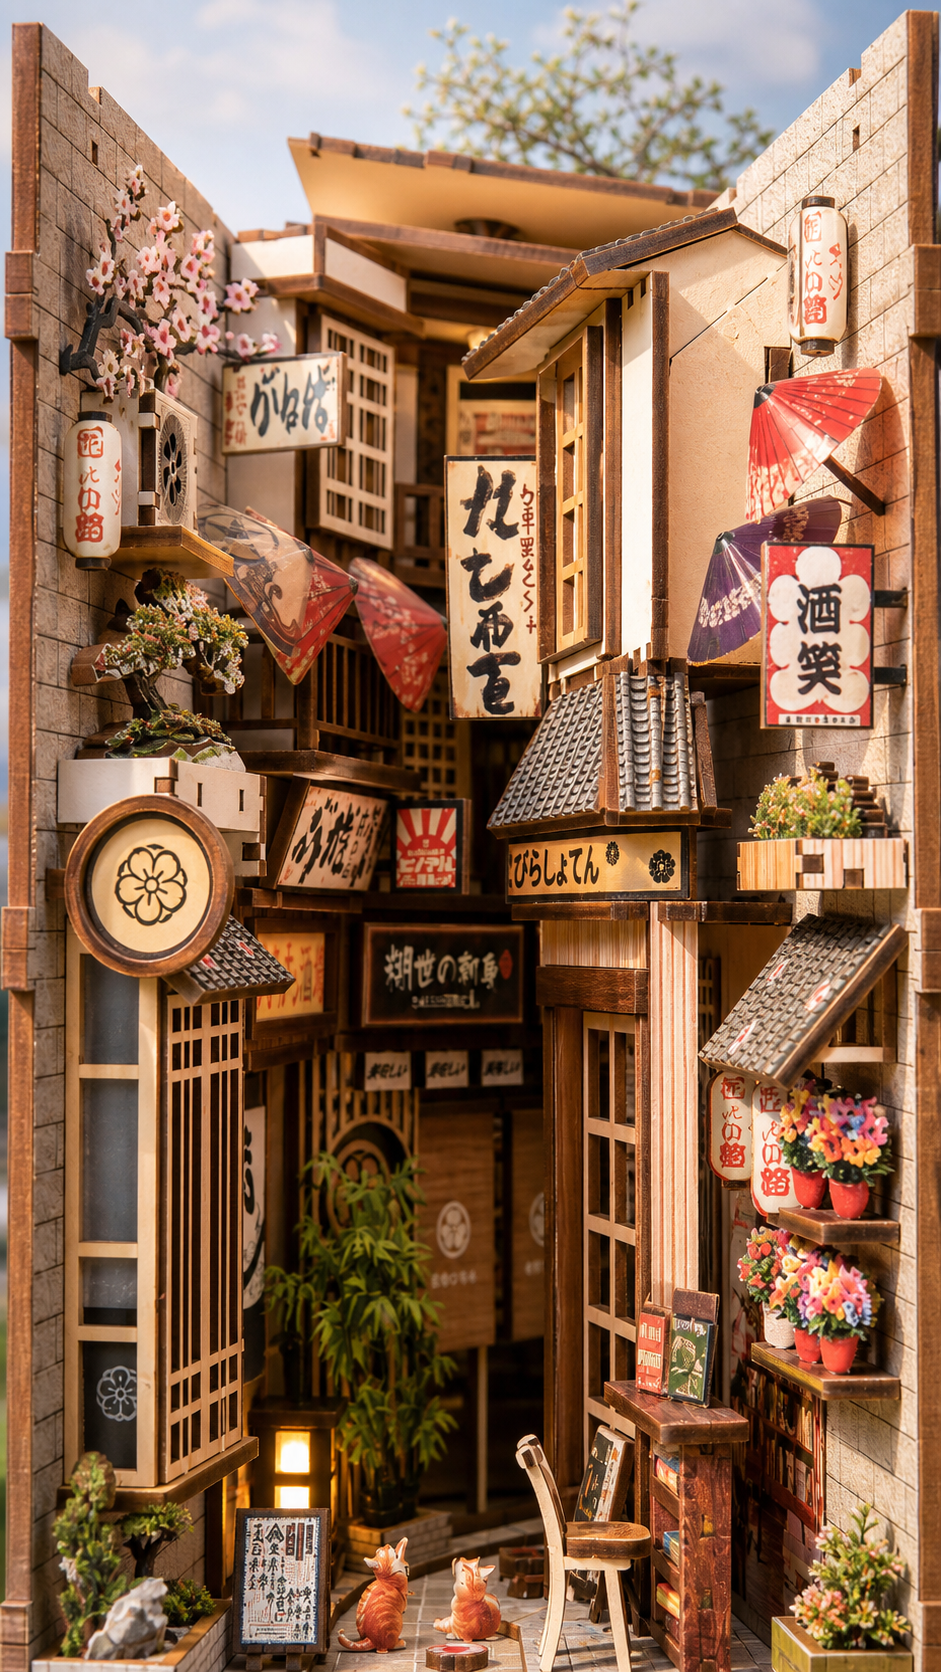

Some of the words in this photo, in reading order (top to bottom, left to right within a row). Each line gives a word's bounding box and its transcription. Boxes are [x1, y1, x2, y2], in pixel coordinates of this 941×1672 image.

[509, 844, 600, 888] びらしょてん
